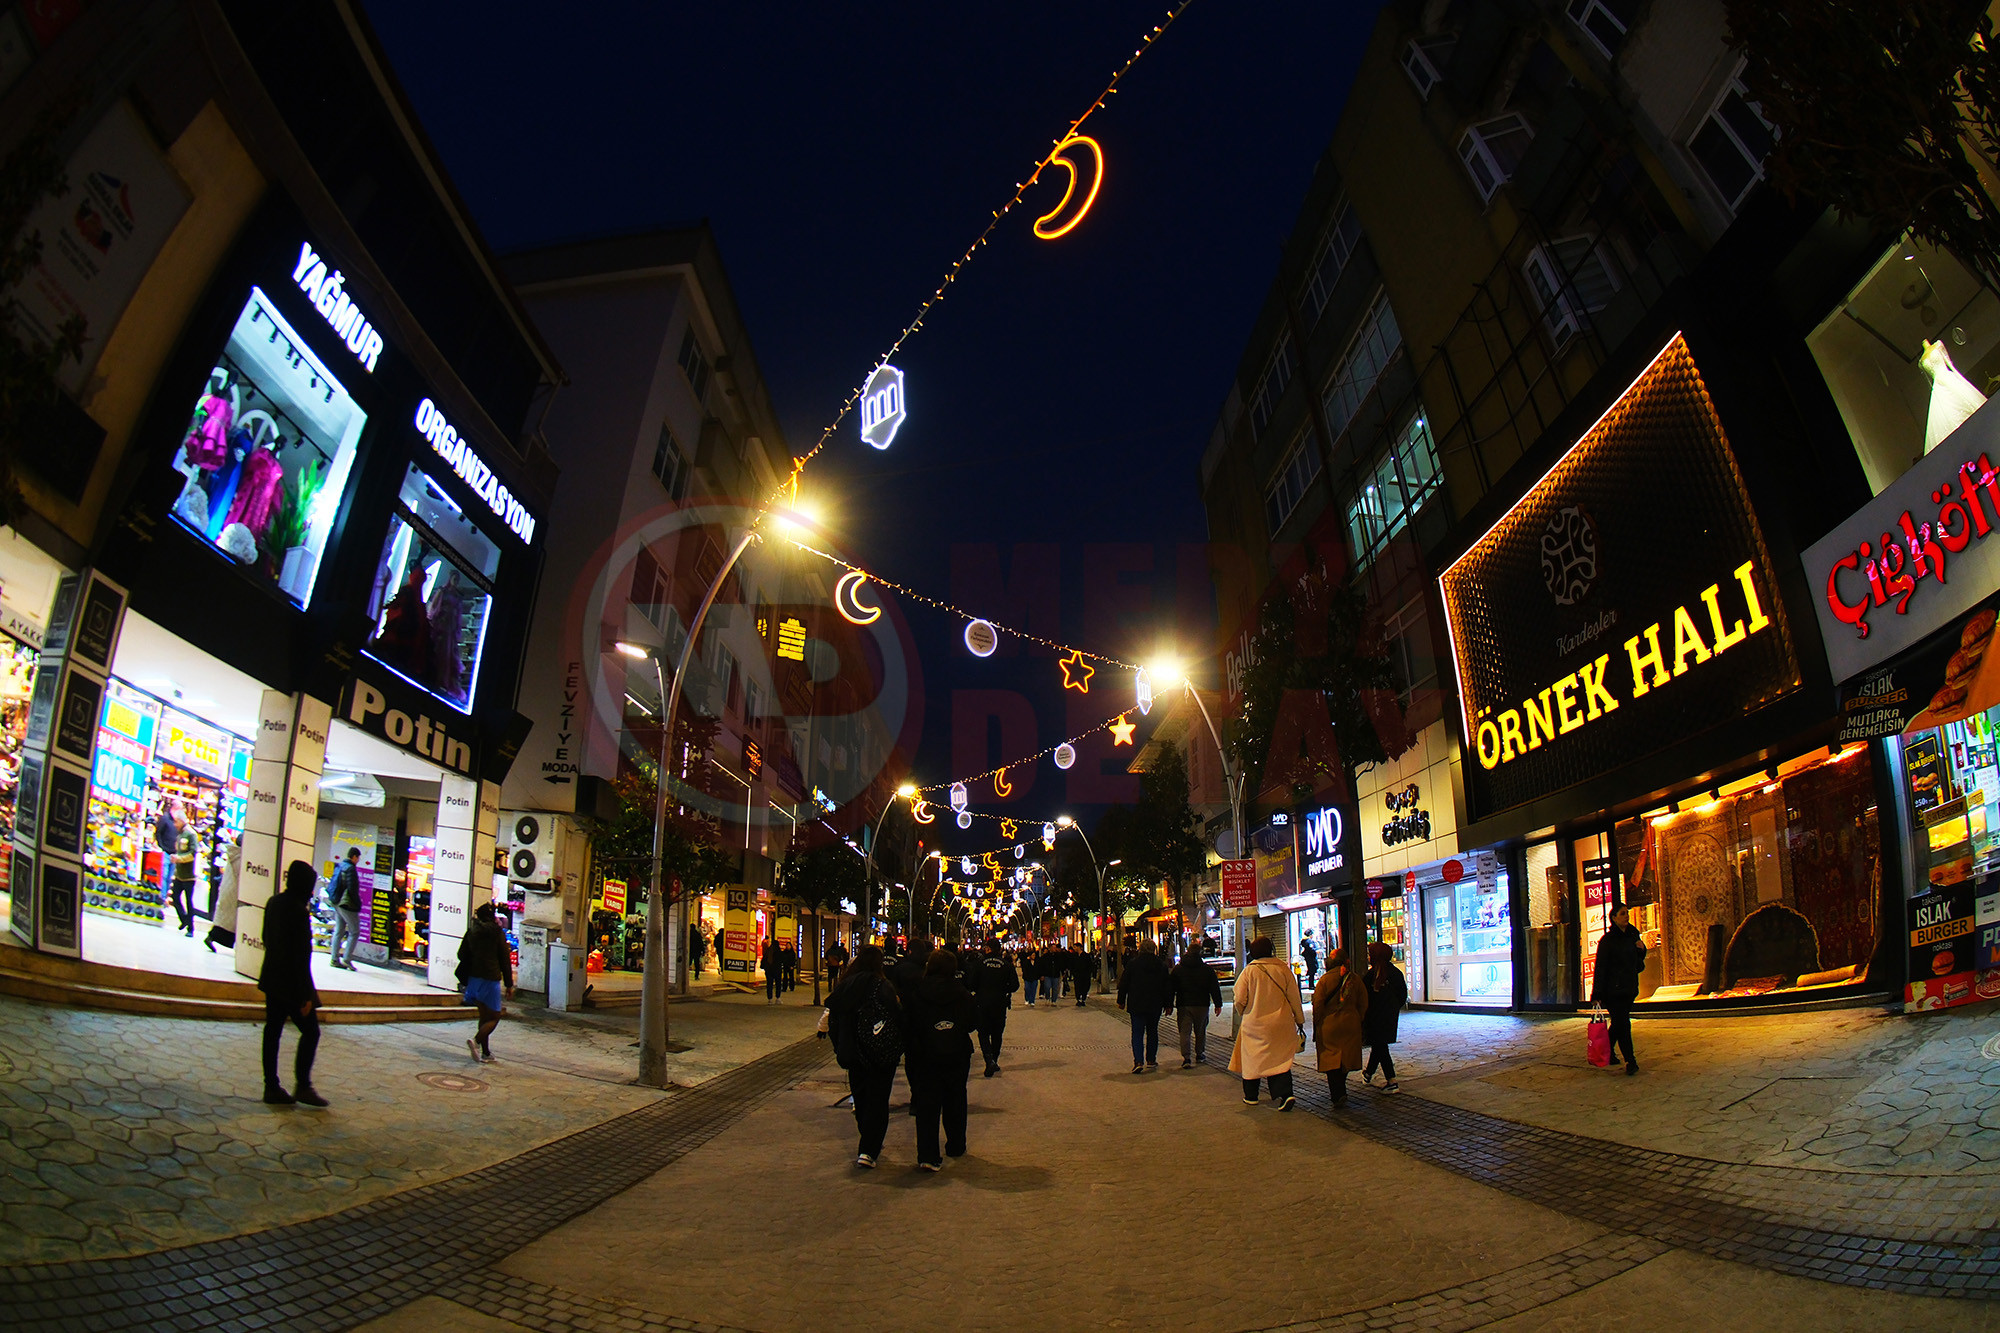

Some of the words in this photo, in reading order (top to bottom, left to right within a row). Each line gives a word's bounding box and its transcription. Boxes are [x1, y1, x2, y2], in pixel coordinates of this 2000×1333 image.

[292, 242, 383, 373] YAĞMUR
[415, 398, 536, 545] ORGANİZASYON
[1477, 653, 1619, 770] ÖRNEK
[1624, 560, 1769, 699] HALI
[1848, 689, 1907, 709] BURGER
[264, 720, 287, 732] Potin
[350, 678, 471, 773] Potin
[1847, 709, 1900, 728] MUTLAKA
[300, 724, 325, 744] Potin
[1840, 718, 1905, 740] DENEMELİSİN
[169, 727, 219, 765] Potin
[542, 762, 578, 773] MODA
[254, 790, 277, 804] Potin
[290, 797, 315, 815] Potin
[446, 796, 469, 807] Potin
[441, 849, 465, 861] Potin
[246, 861, 269, 878] Potin
[438, 902, 462, 914] Potin
[1917, 901, 1952, 927] ISLAK
[1918, 919, 1968, 943] BURGER
